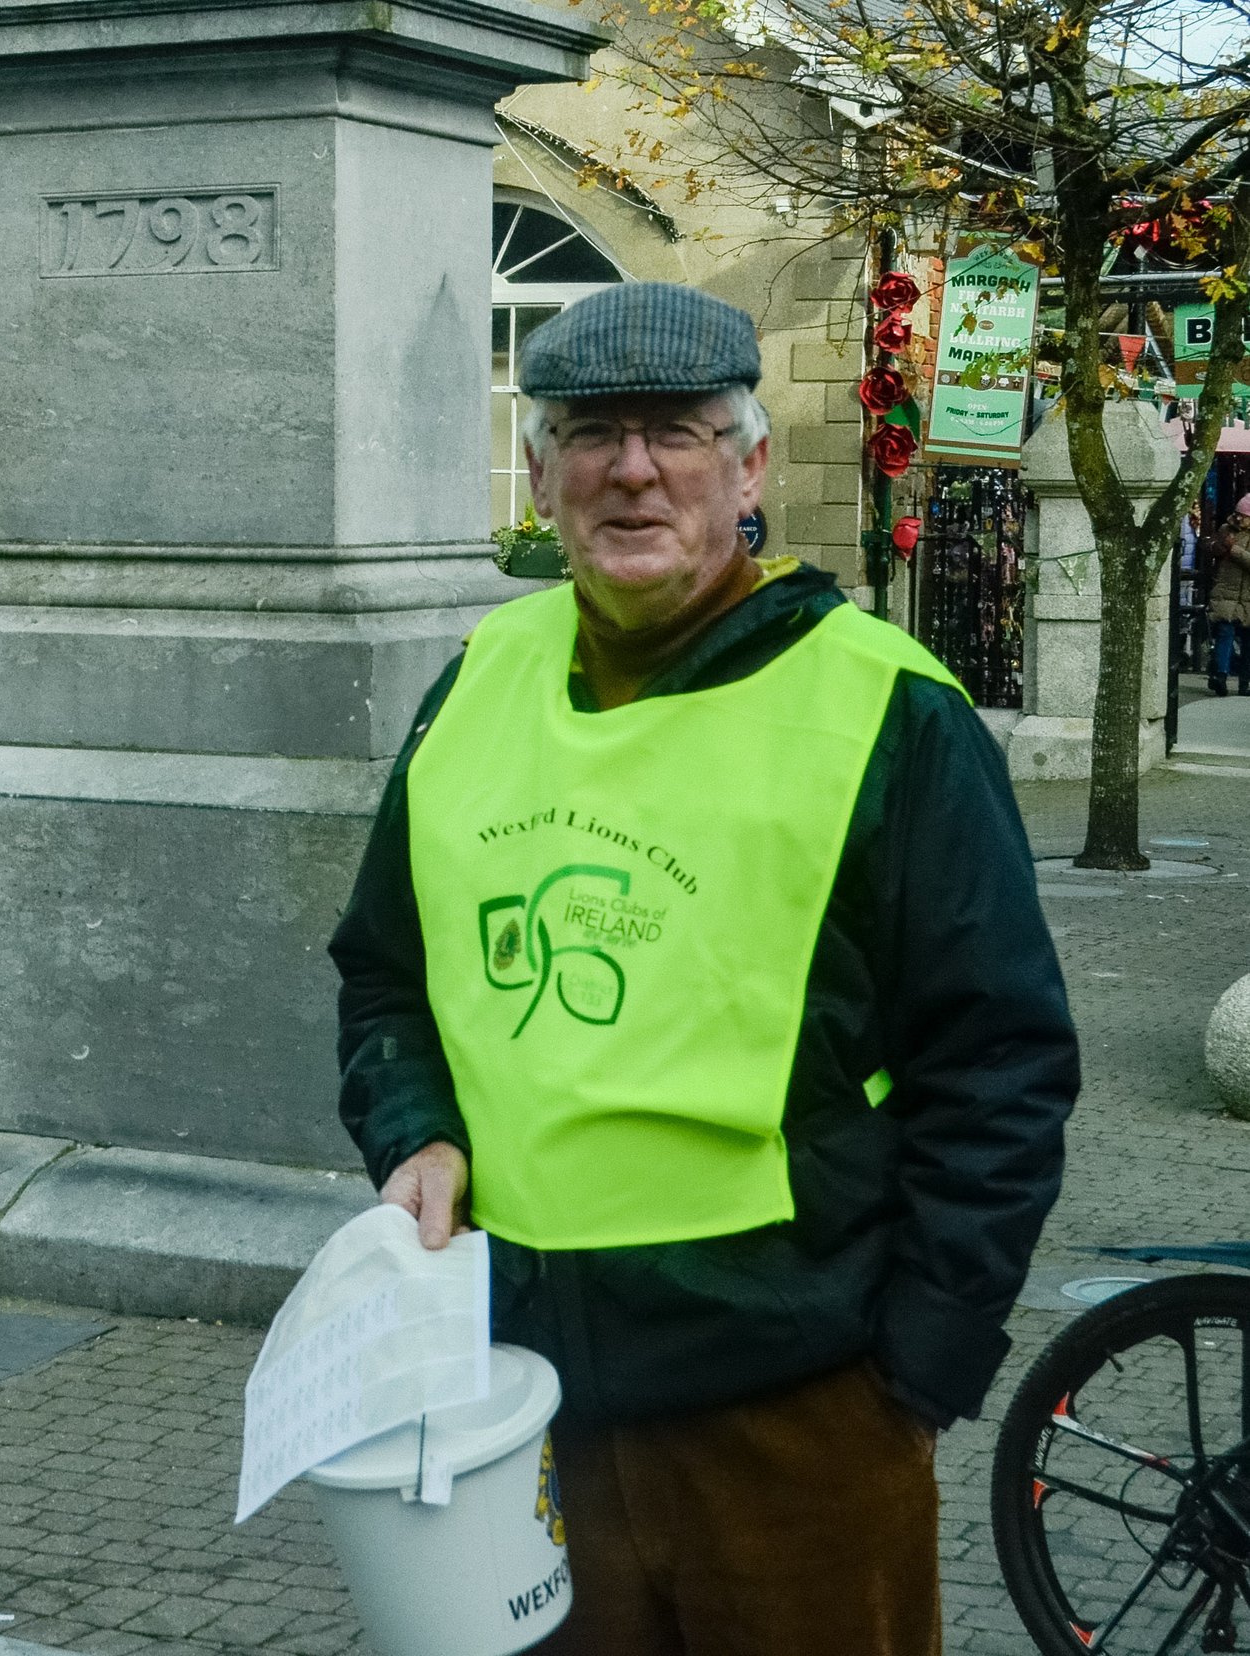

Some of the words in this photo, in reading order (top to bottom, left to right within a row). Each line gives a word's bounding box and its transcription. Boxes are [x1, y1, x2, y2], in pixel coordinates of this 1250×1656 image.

[59, 194, 263, 272] 1798
[945, 406, 969, 417] FRIDAY
[976, 411, 1009, 419] SATURDAY
[567, 810, 642, 852] Lions
[646, 845, 698, 895] Club
[564, 902, 662, 942] IRELAND
